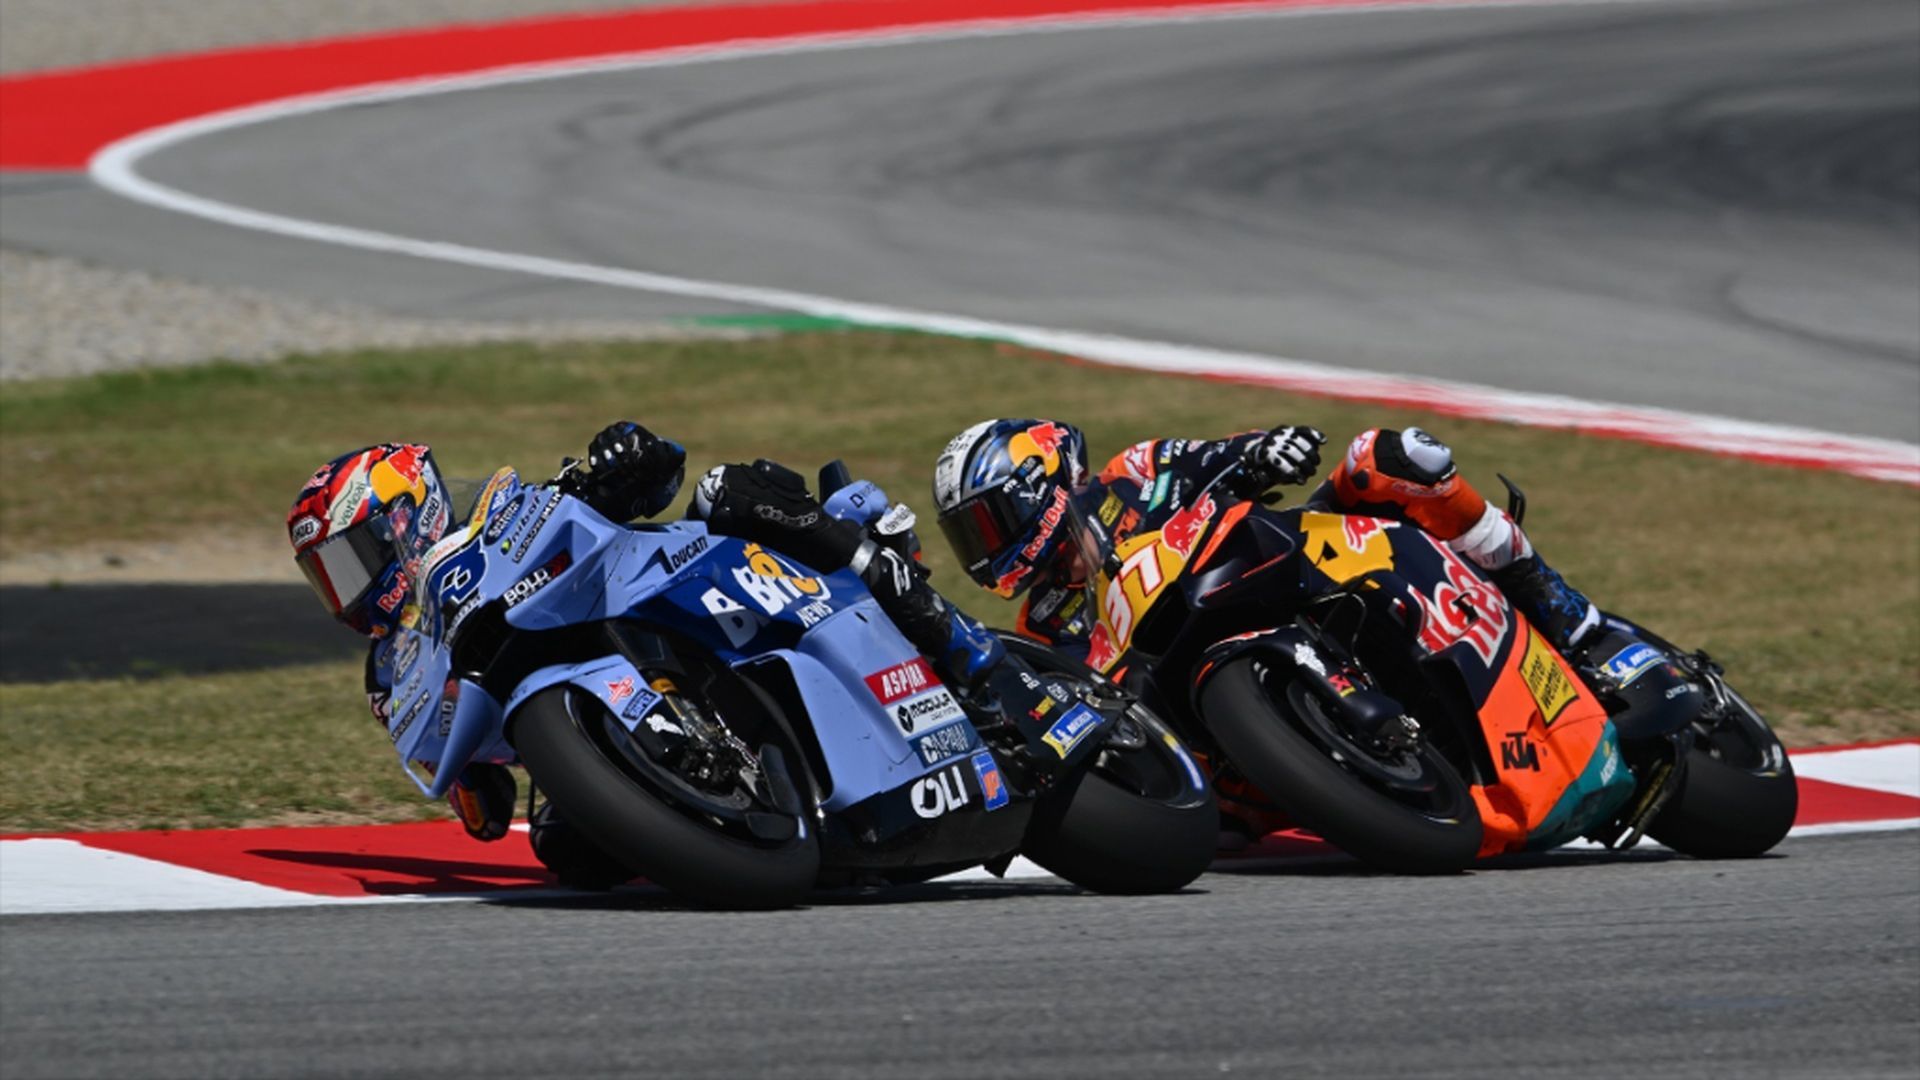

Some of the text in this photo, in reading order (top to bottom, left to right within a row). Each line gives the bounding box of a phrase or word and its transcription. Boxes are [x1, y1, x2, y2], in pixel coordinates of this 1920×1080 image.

[1021, 518, 1053, 561] Red
[1042, 485, 1069, 529] Bull
[671, 535, 709, 570] DUCATI
[376, 571, 410, 614] Red
[503, 567, 549, 604] BOLD
[1105, 539, 1162, 651] 37
[796, 600, 834, 629] NEWS
[1501, 731, 1540, 772] KTM
[910, 765, 969, 819] OLI
